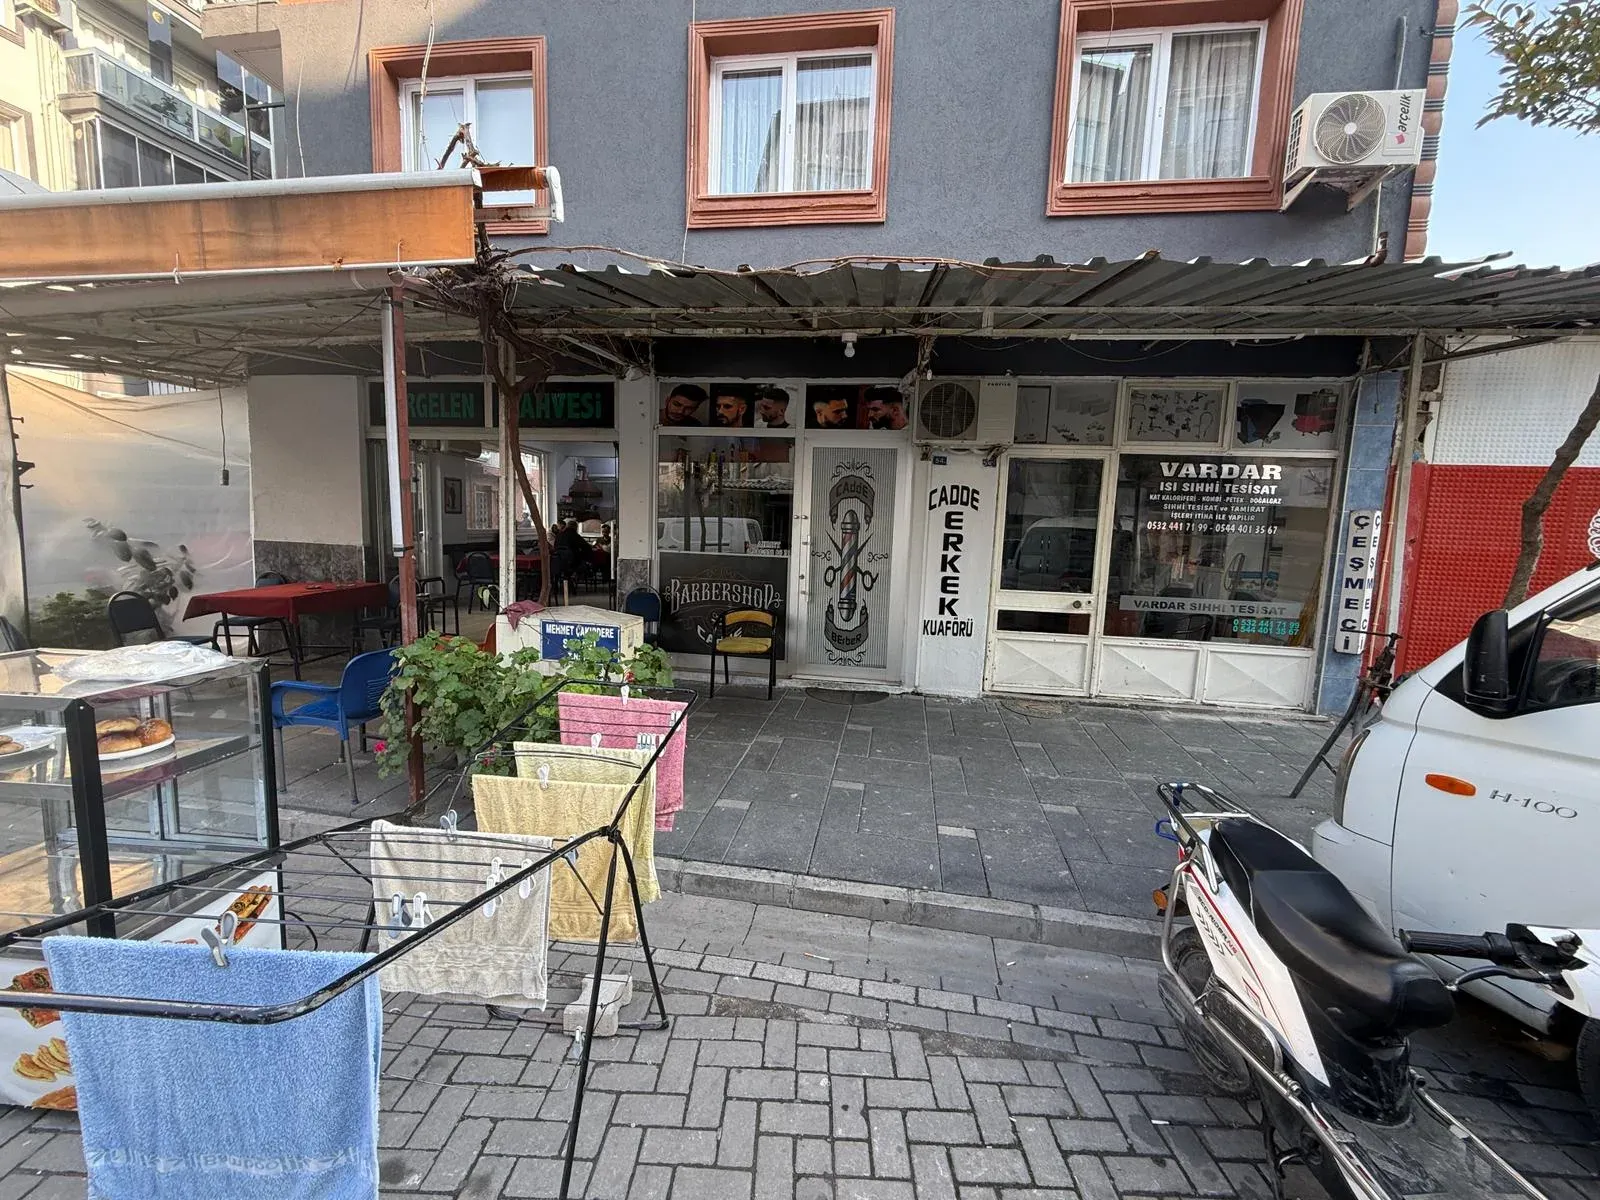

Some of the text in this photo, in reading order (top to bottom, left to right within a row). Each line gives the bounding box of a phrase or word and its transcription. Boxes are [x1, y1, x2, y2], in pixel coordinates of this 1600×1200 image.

[1397, 94, 1411, 132] arçelik
[1159, 462, 1282, 480] VARDAR
[1159, 481, 1278, 495] ISI SIHHİ TESİSAT
[928, 485, 980, 511] CADDE
[1147, 521, 1167, 530] 0532
[1168, 521, 1183, 531] 441
[1186, 522, 1195, 532] 71
[1197, 523, 1208, 532] 99
[1215, 523, 1236, 533] 0544
[1237, 524, 1253, 534] 401
[1255, 525, 1266, 534] 35
[1267, 526, 1278, 535] 67
[938, 511, 964, 616] ERKEK
[1133, 599, 1185, 611] VARDAR
[545, 623, 575, 636] MEHMET
[922, 617, 974, 637] KUAFÖRÜ
[1240, 619, 1257, 627] 532
[1489, 789, 1578, 819] H-100
